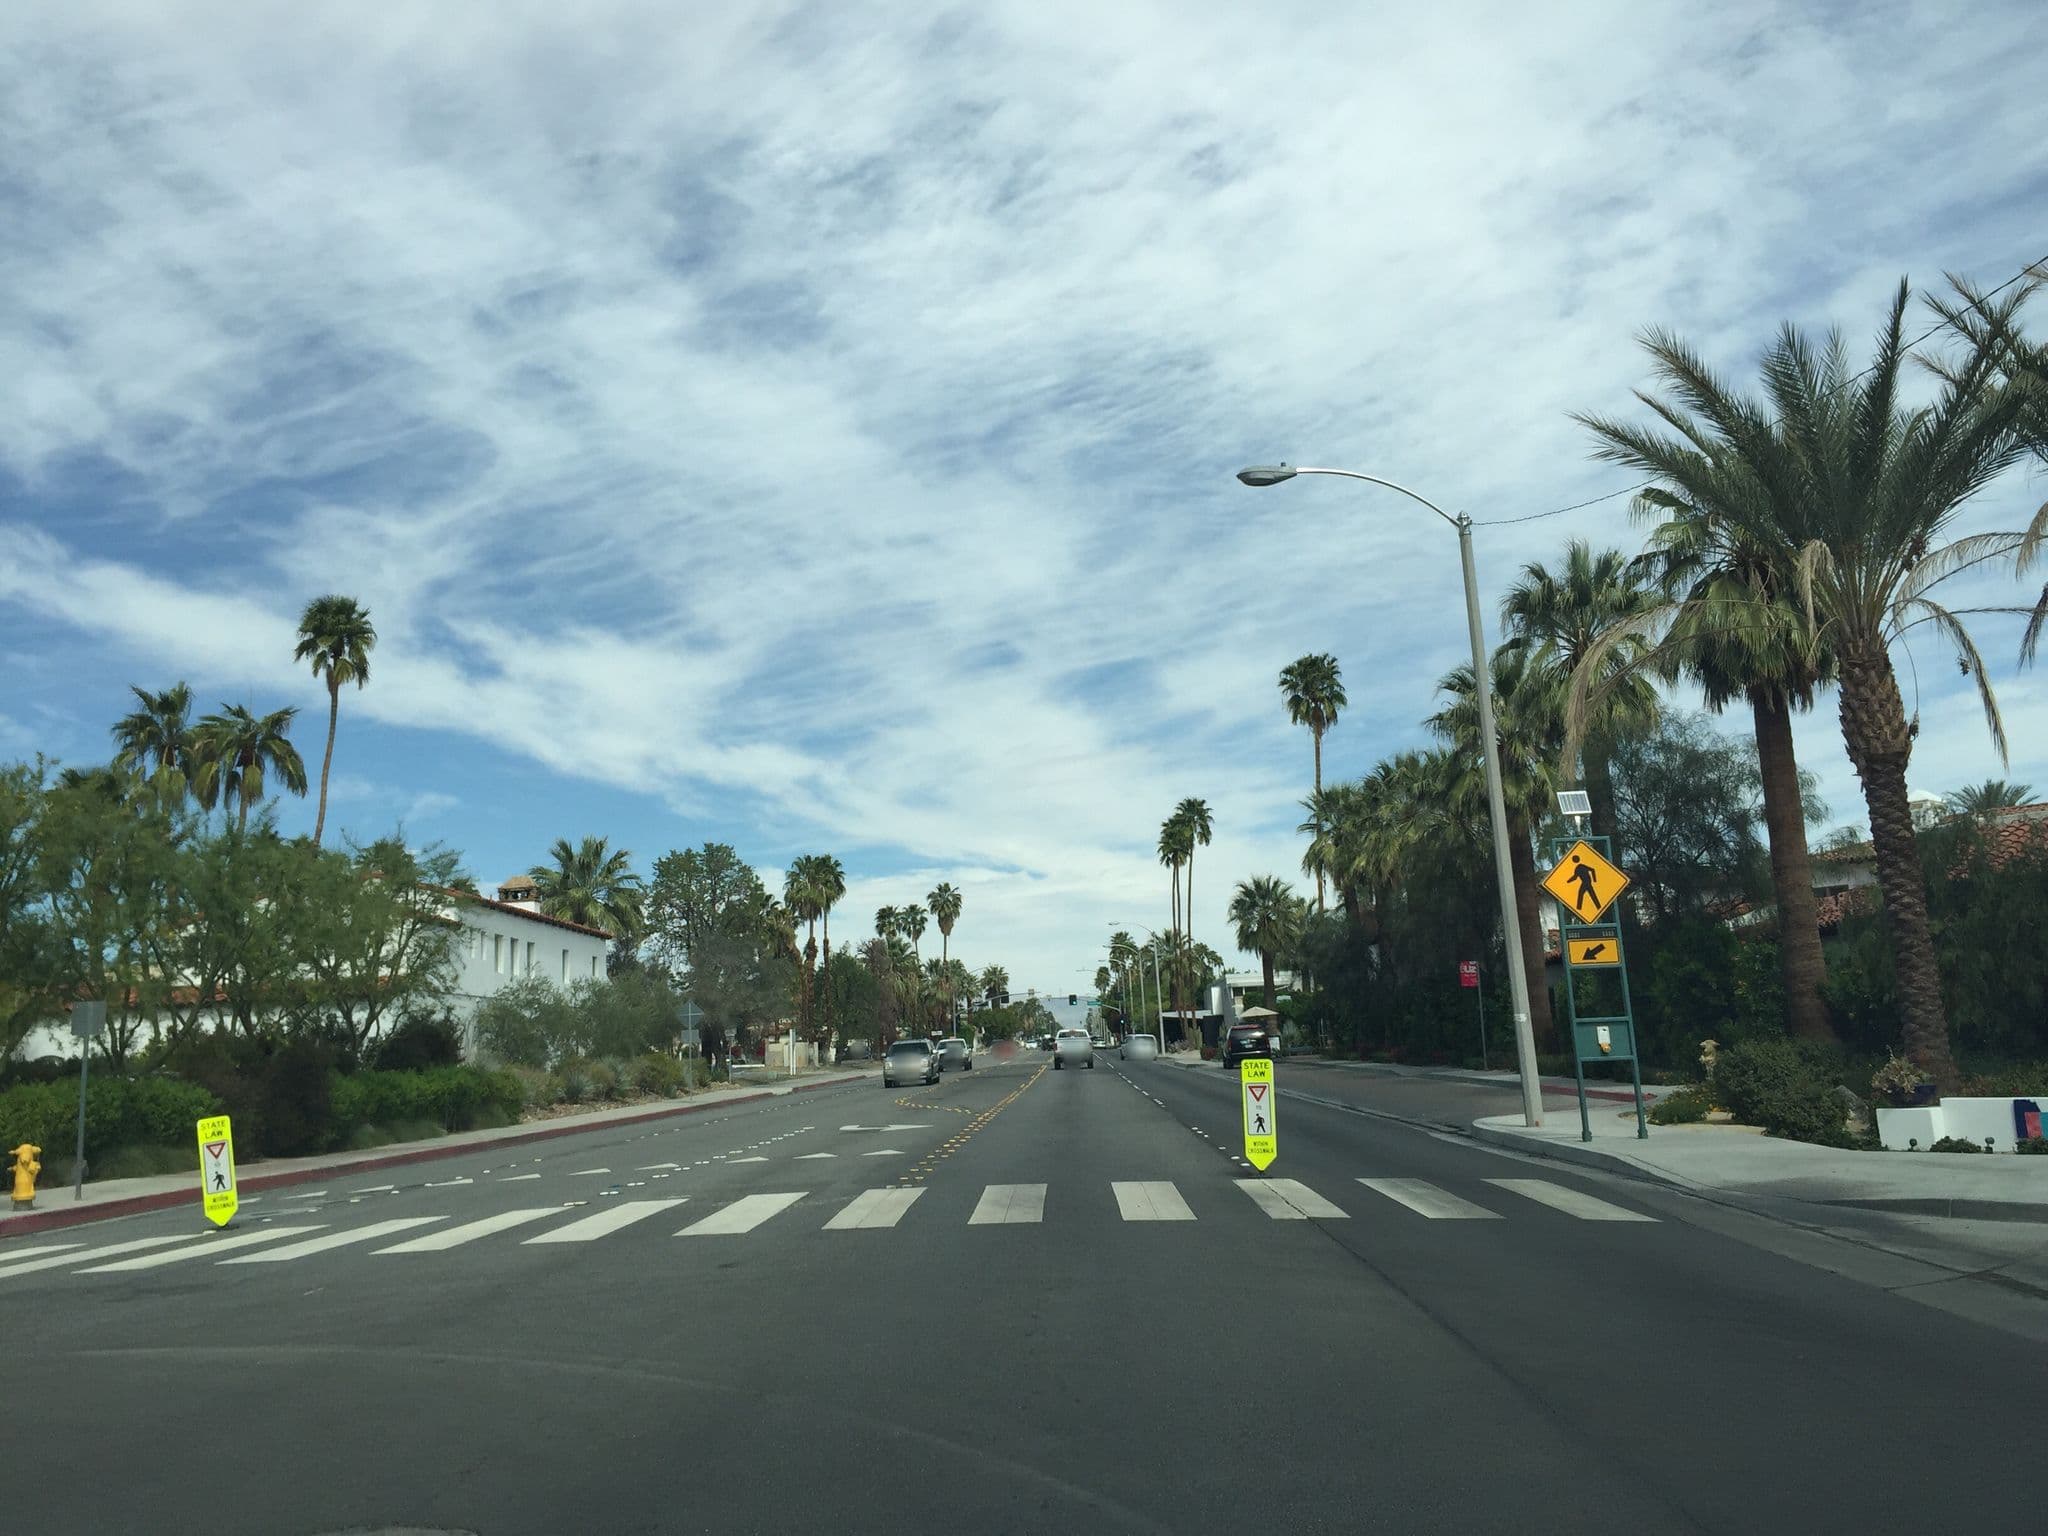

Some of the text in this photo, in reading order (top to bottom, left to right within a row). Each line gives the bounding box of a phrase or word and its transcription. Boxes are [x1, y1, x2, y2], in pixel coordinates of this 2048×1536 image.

[1243, 1062, 1270, 1070] STATE
[200, 1120, 226, 1131] STATE
[204, 1130, 223, 1140] LAW
